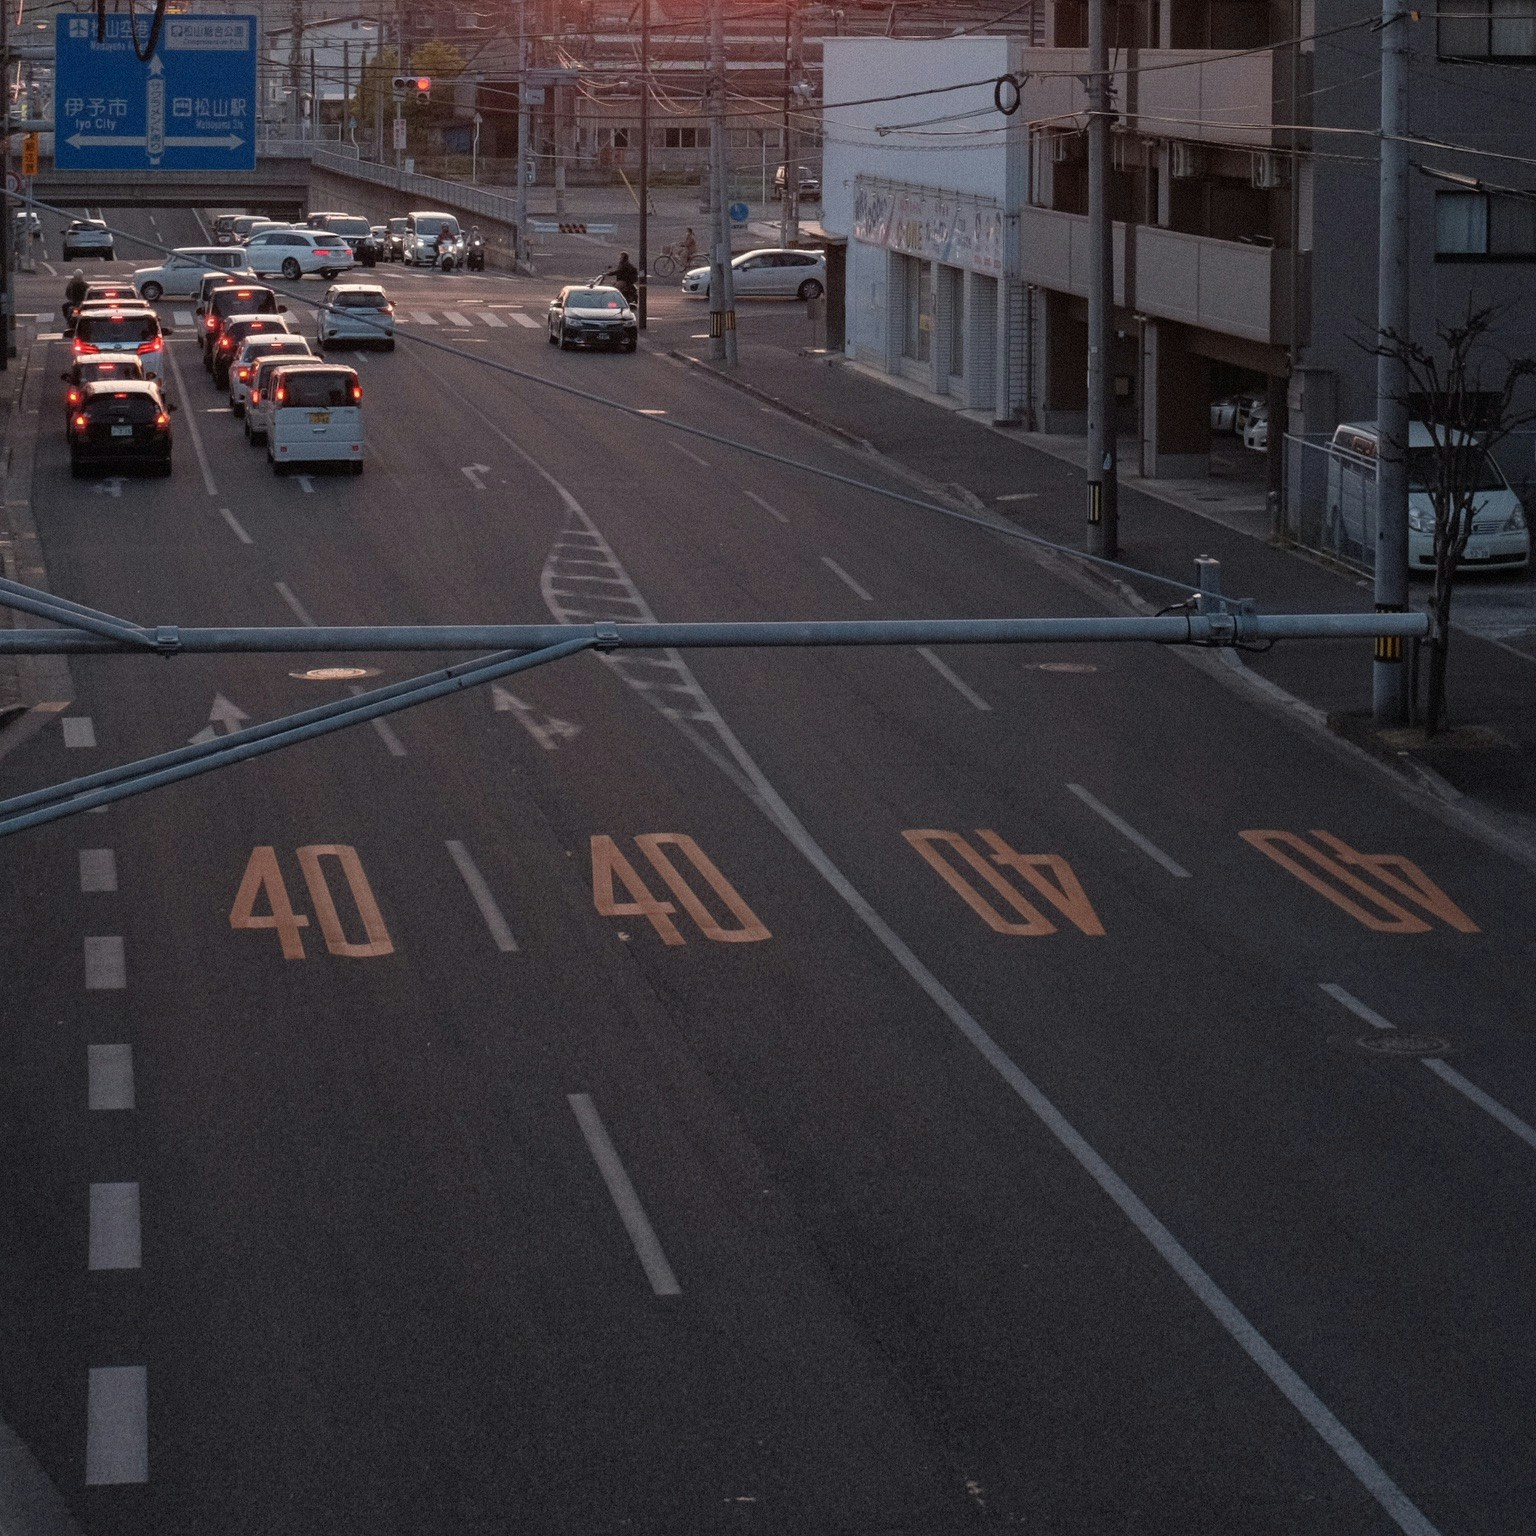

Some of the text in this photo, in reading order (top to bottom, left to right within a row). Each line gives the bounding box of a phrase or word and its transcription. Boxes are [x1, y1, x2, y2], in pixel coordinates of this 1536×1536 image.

[64, 97, 128, 118] 伊予市
[75, 118, 117, 131] Iyo City
[195, 97, 247, 118] 松山駅
[229, 844, 394, 960] 40
[590, 833, 773, 945] 40
[901, 829, 1108, 936] 40
[1238, 829, 1483, 934] 40
